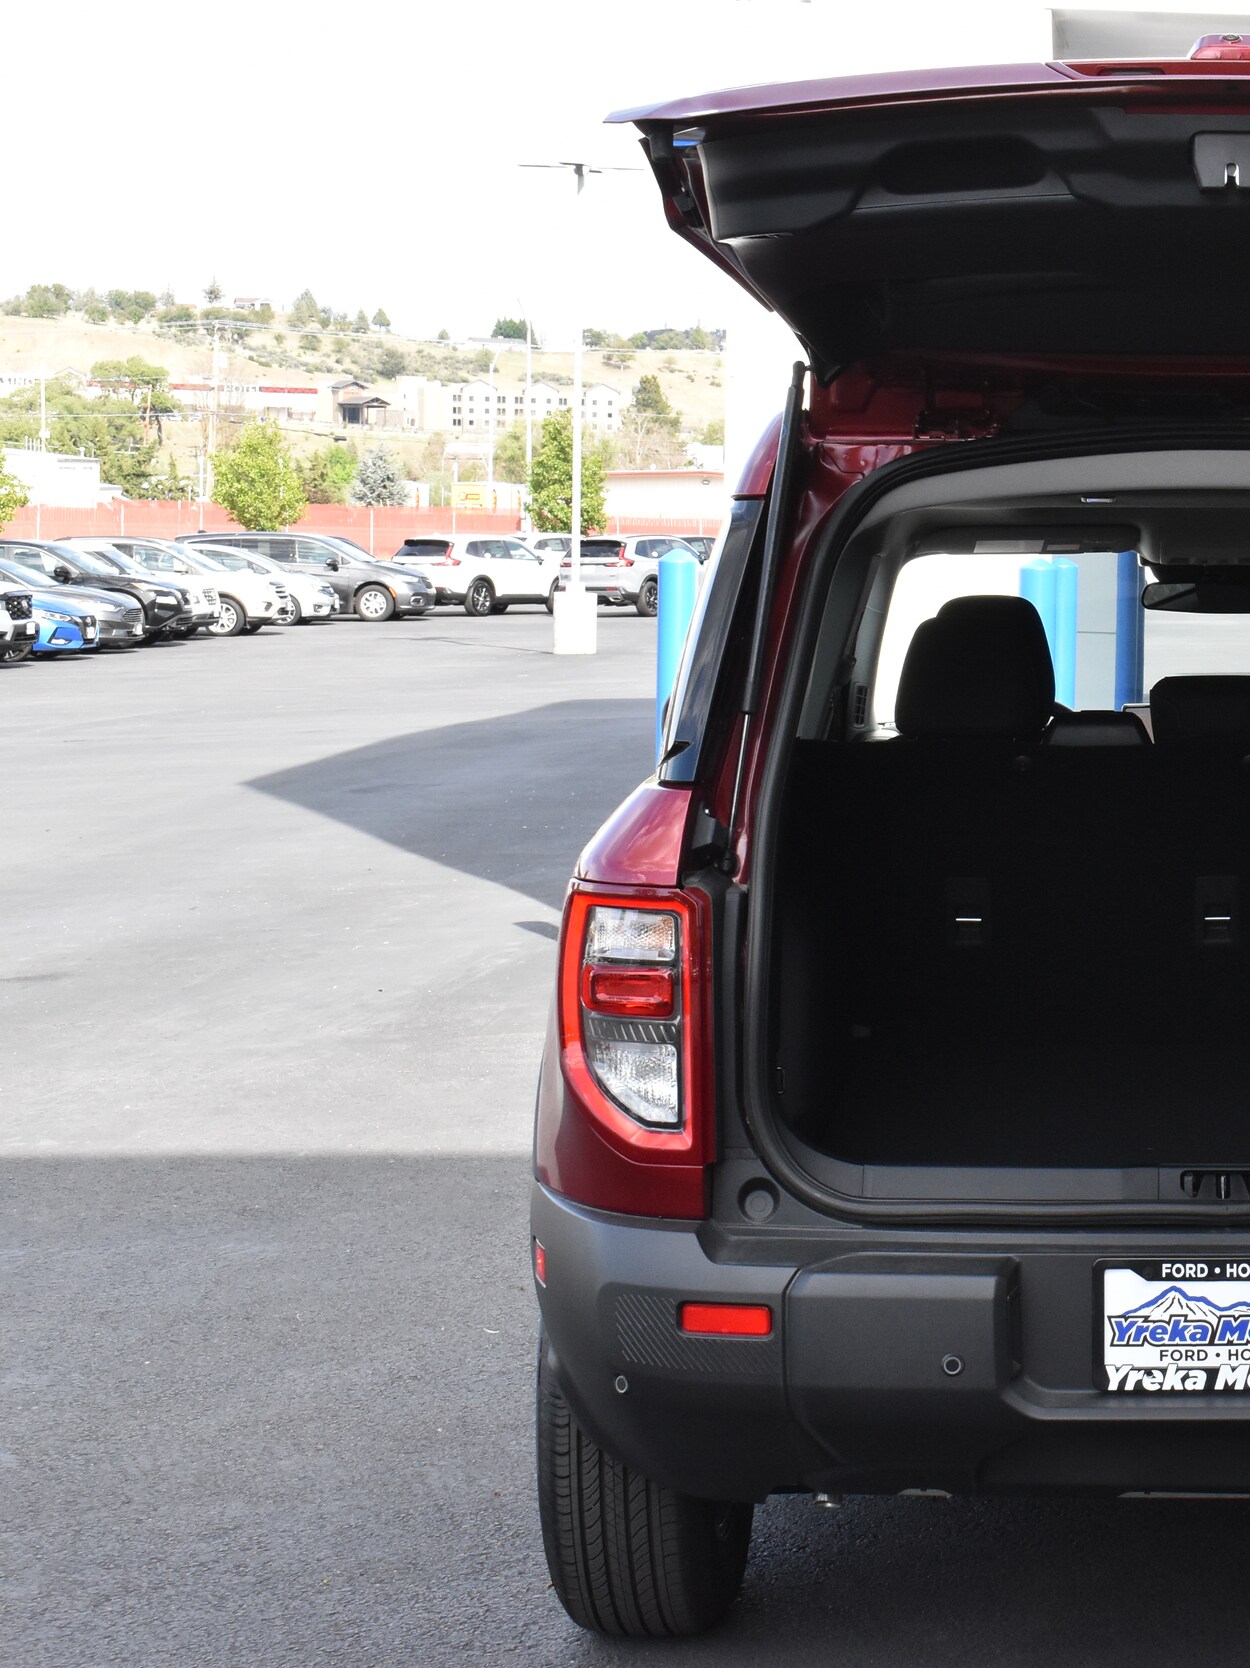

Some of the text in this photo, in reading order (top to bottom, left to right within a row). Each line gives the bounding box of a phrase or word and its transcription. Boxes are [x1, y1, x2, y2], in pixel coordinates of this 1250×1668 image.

[1161, 1263, 1209, 1278] FORD
[1108, 1315, 1212, 1345] Yreka
[1159, 1349, 1208, 1361] FORD
[1104, 1363, 1208, 1391] Yreka
